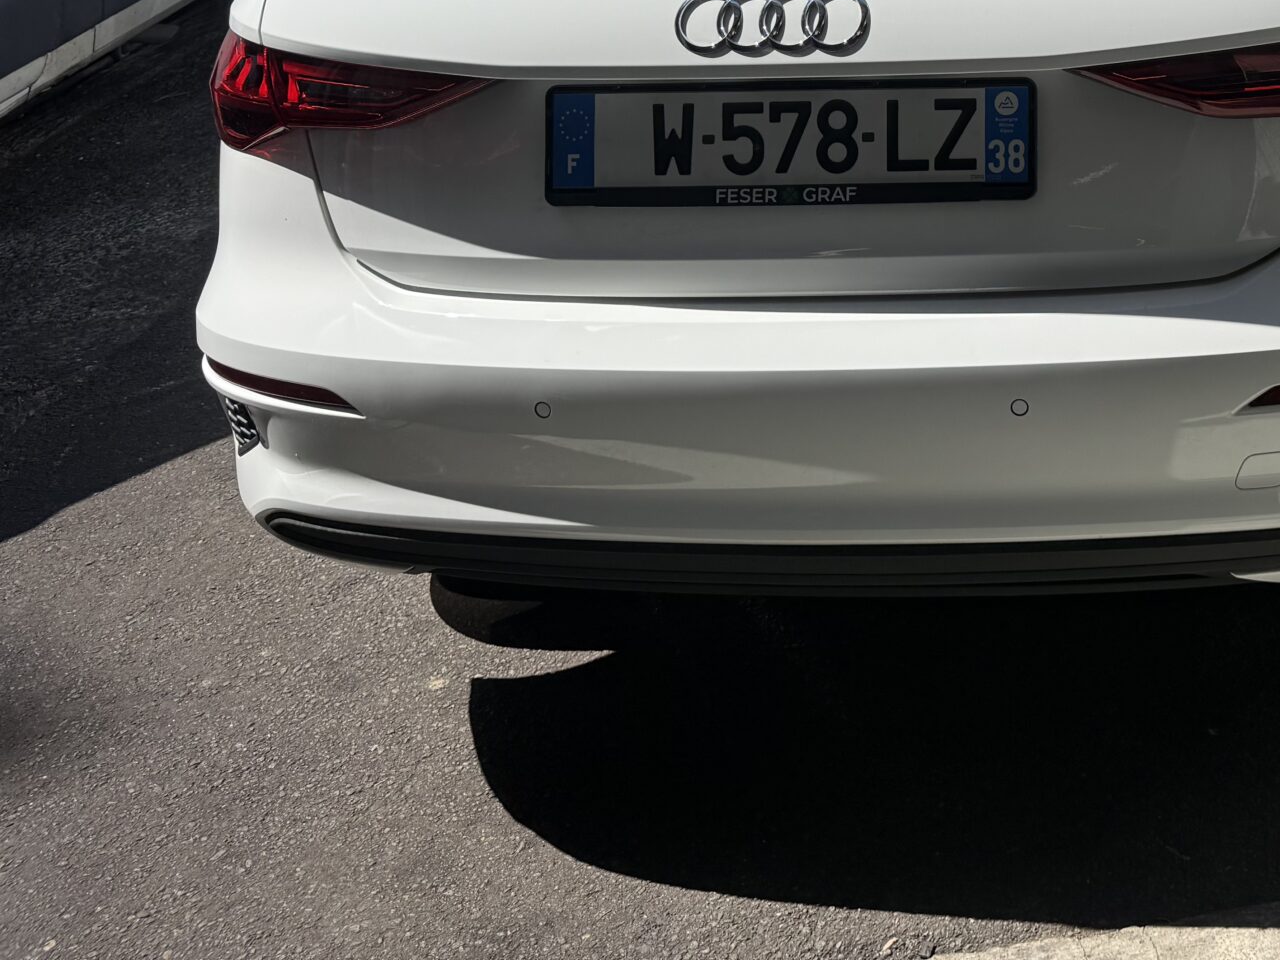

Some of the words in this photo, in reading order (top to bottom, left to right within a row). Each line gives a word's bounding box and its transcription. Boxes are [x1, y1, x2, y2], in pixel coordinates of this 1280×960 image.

[652, 98, 978, 176] W-578-LZ
[567, 153, 580, 175] F
[987, 138, 1026, 174] 38
[715, 188, 778, 204] FESER
[802, 186, 858, 203] GRAF
